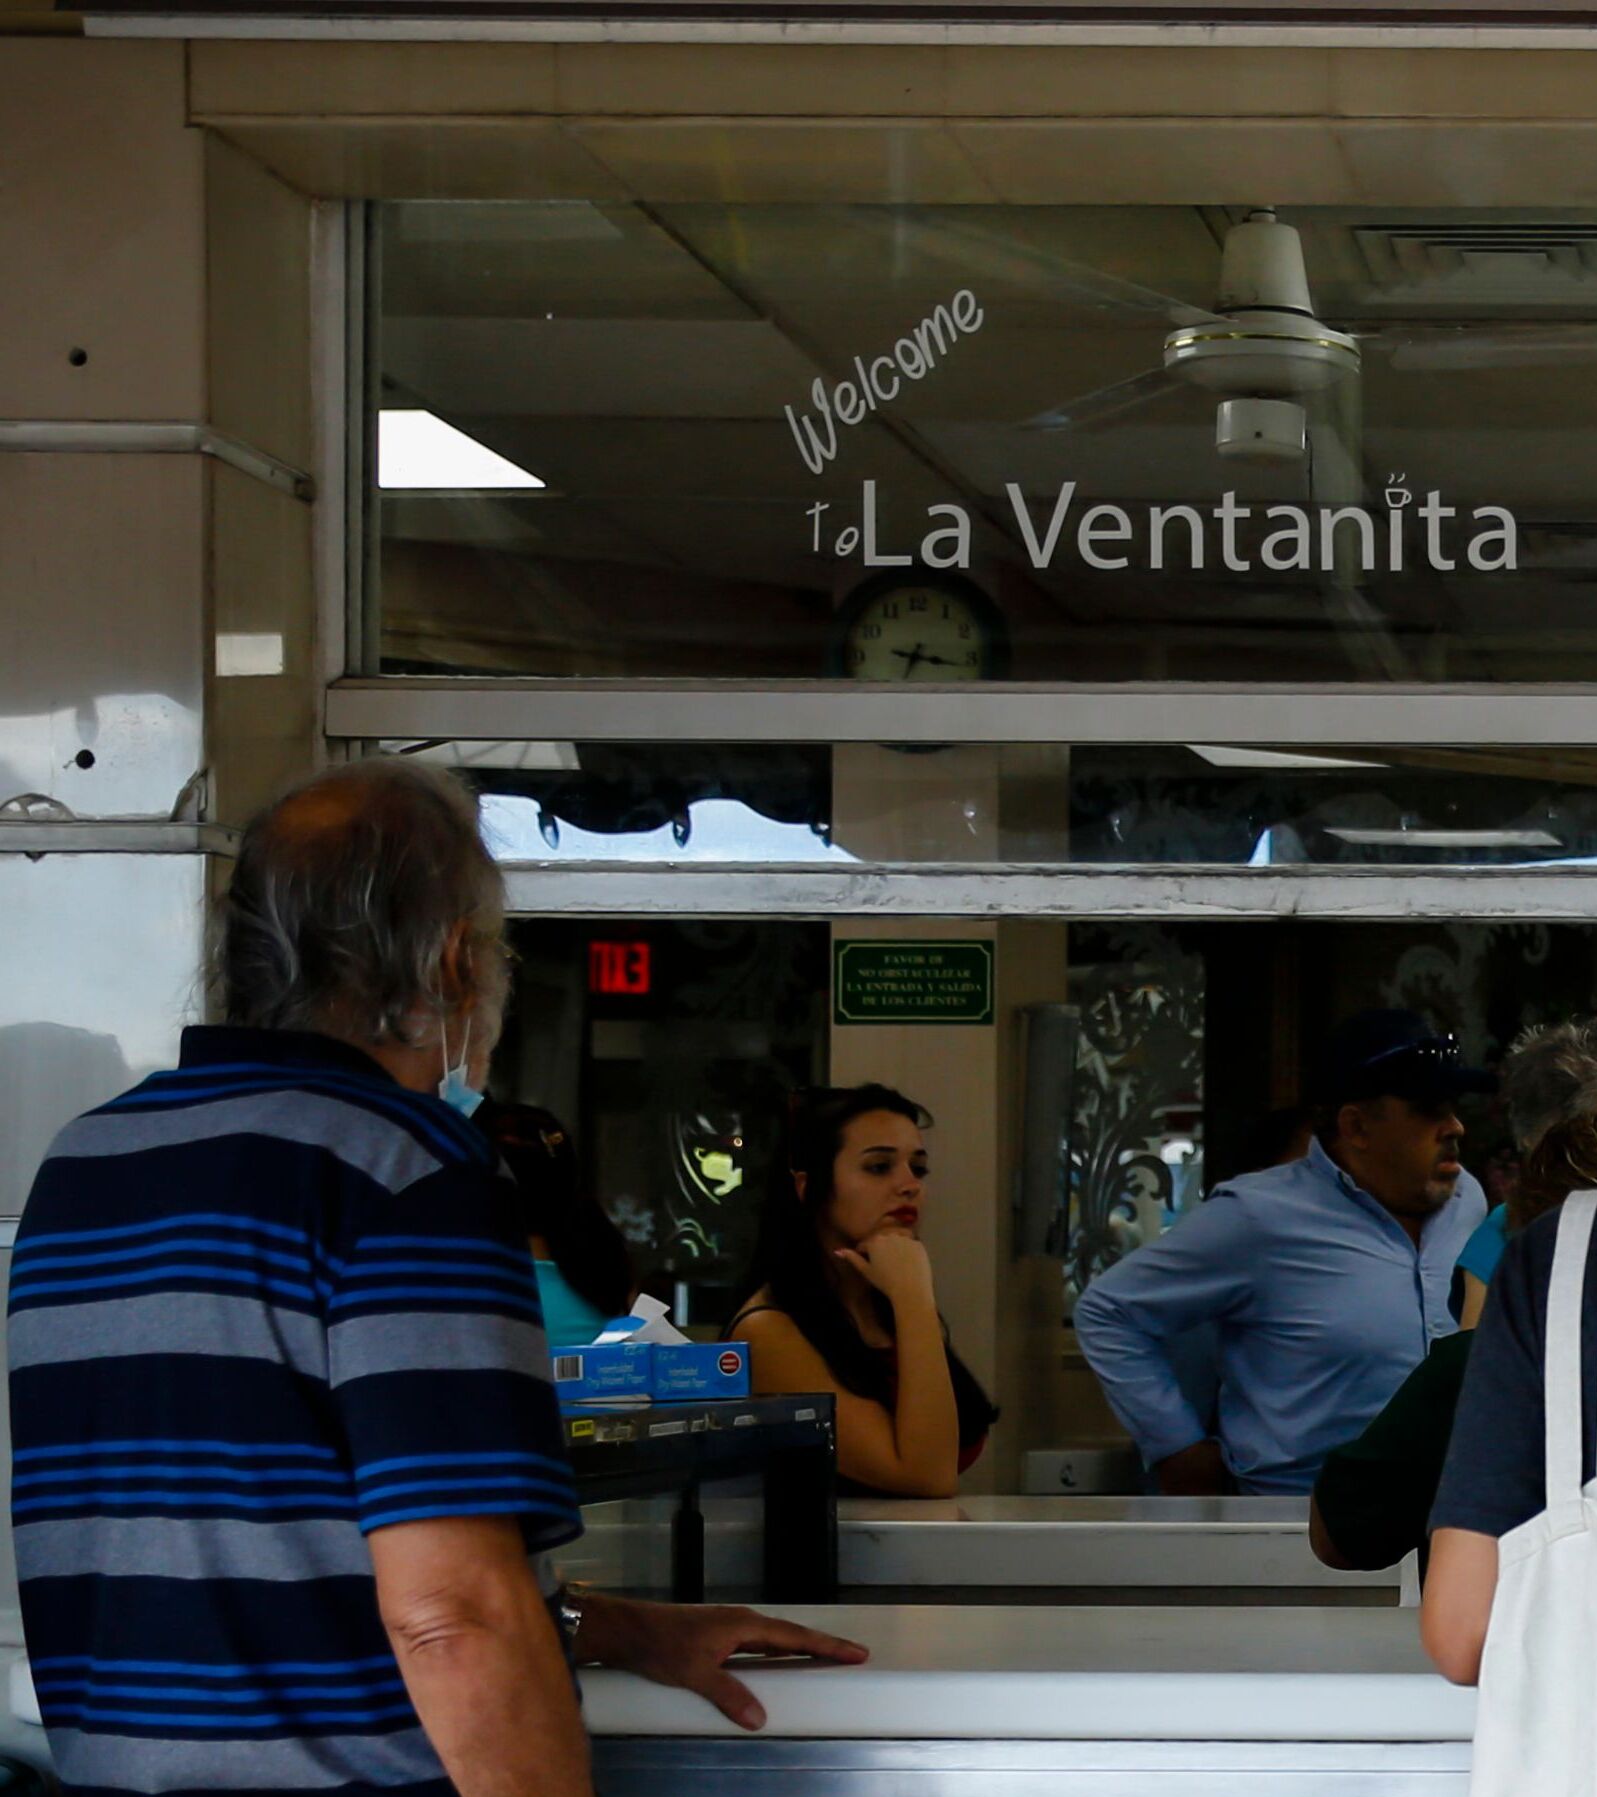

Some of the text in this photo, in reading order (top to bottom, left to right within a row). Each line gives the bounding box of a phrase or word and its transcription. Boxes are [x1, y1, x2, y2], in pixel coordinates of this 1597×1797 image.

[784, 288, 984, 475] Welcome
[862, 474, 1518, 571] La Ventanita
